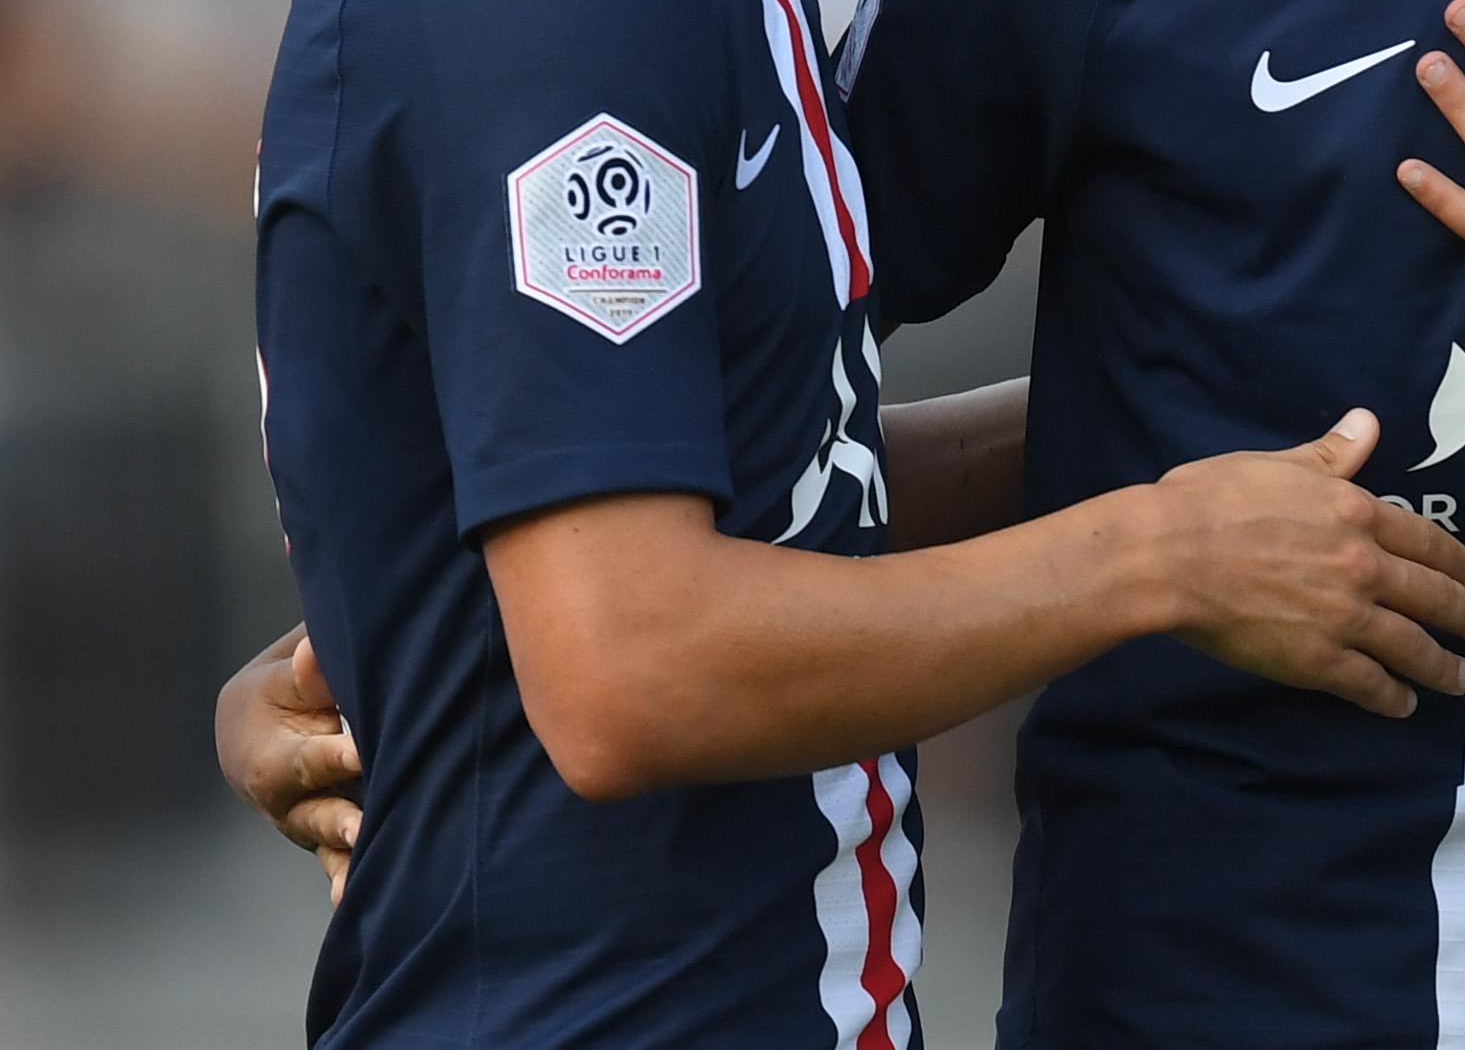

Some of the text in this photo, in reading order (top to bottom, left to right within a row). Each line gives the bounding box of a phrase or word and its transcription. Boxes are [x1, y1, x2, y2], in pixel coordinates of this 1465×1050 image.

[564, 246, 661, 263] LIGUE 1
[566, 264, 662, 282] Conforama
